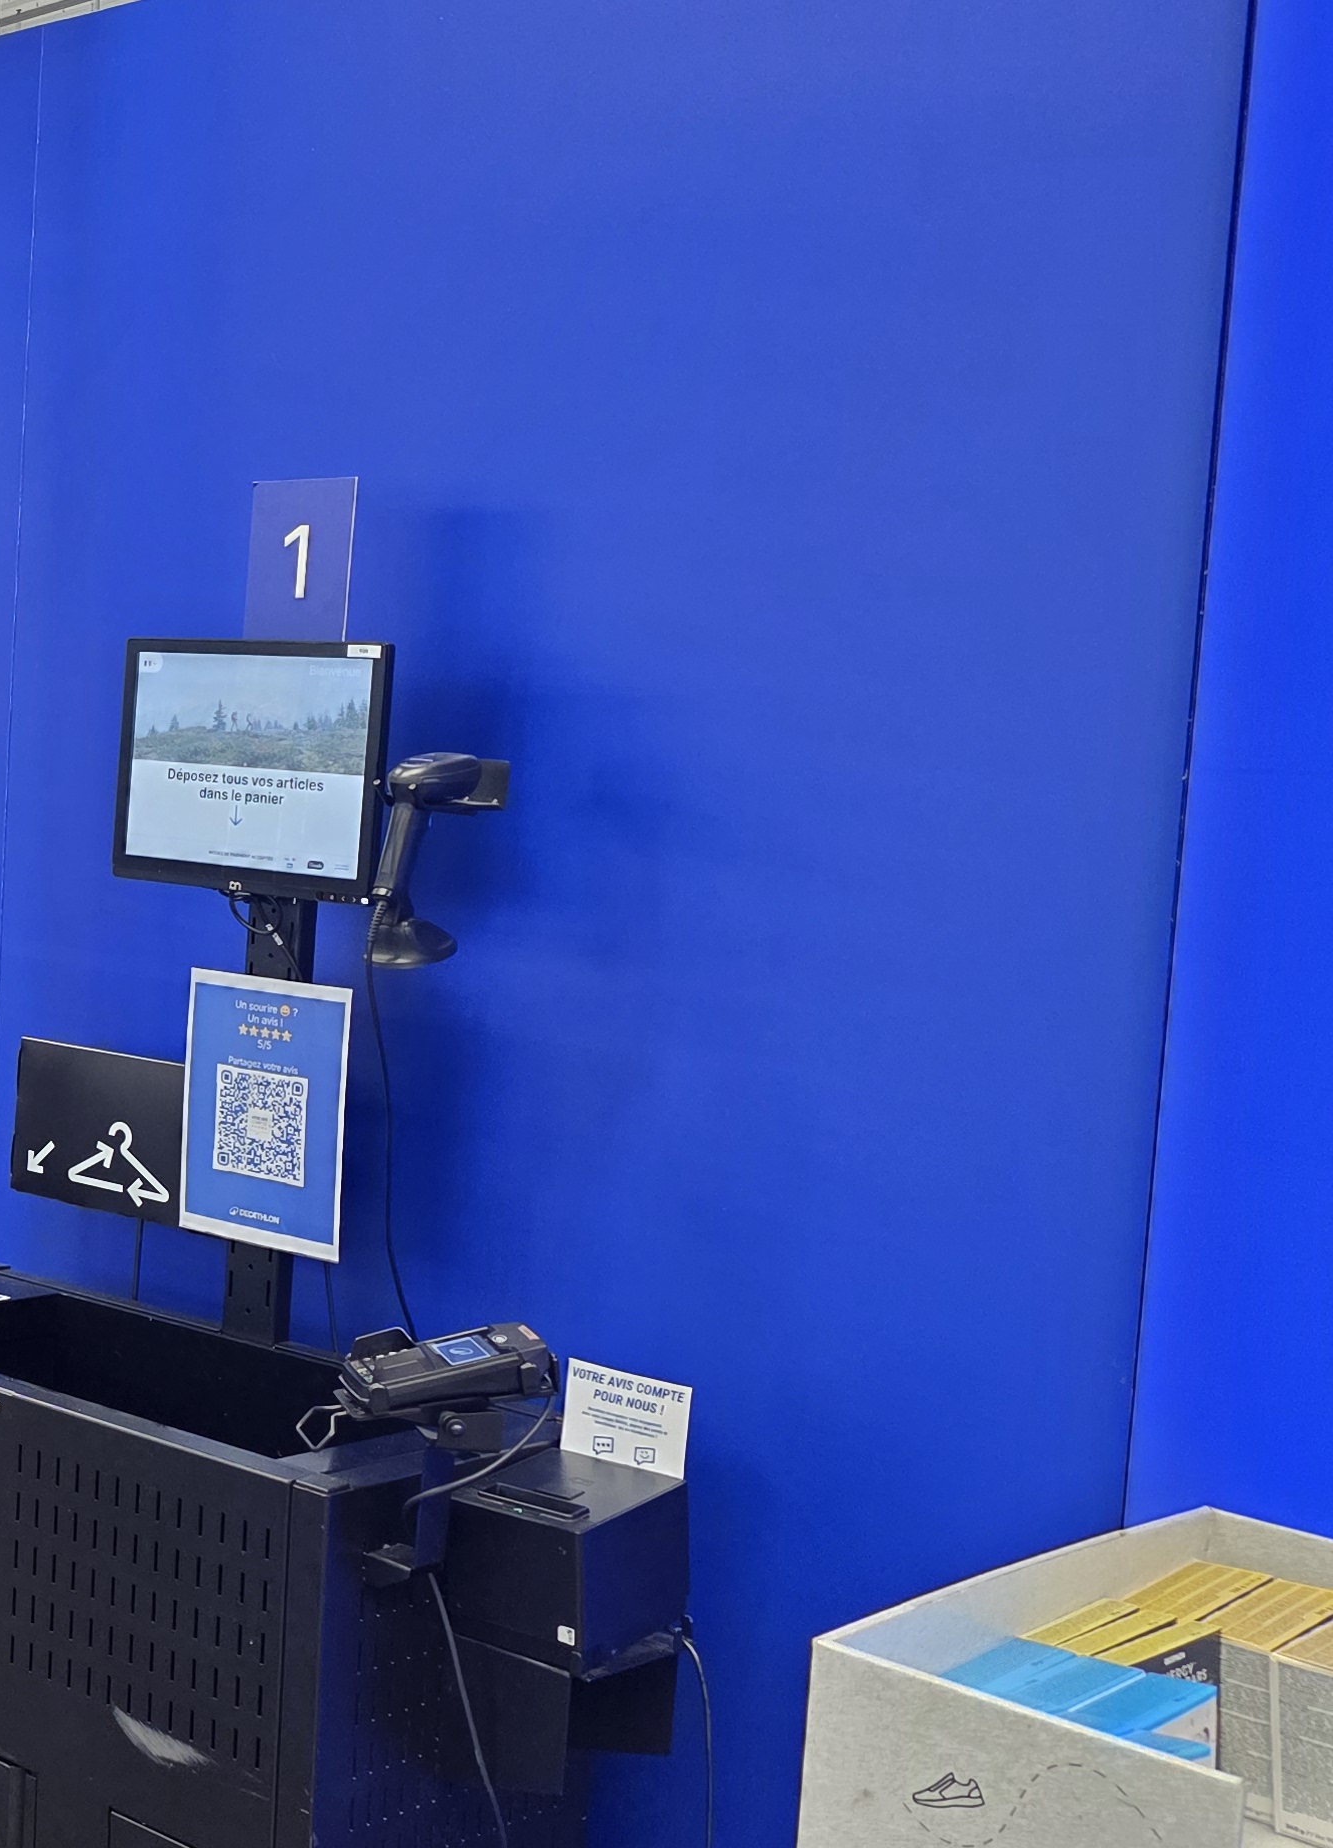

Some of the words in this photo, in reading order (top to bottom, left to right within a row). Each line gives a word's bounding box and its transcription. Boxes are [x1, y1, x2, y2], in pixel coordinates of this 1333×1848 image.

[284, 525, 310, 599] 1
[167, 768, 219, 783] Déposez
[222, 772, 249, 786] tous
[252, 776, 273, 788] vos
[276, 777, 324, 792] articles
[199, 787, 228, 800] dans
[231, 789, 242, 801] le
[244, 791, 284, 805] panier
[235, 999, 247, 1009] Un
[249, 1003, 278, 1014] sourire
[247, 1014, 260, 1024] Un
[261, 1017, 279, 1027] avis
[228, 1055, 261, 1069] Partagez
[263, 1062, 282, 1072] votre
[282, 1065, 299, 1075] avis
[239, 1208, 280, 1225] DECATHLON
[572, 1366, 607, 1385] VOTRE
[607, 1376, 634, 1391] AVIS
[636, 1382, 686, 1403] COMPTE
[593, 1389, 624, 1406] POUR
[625, 1397, 658, 1414] NOUS
